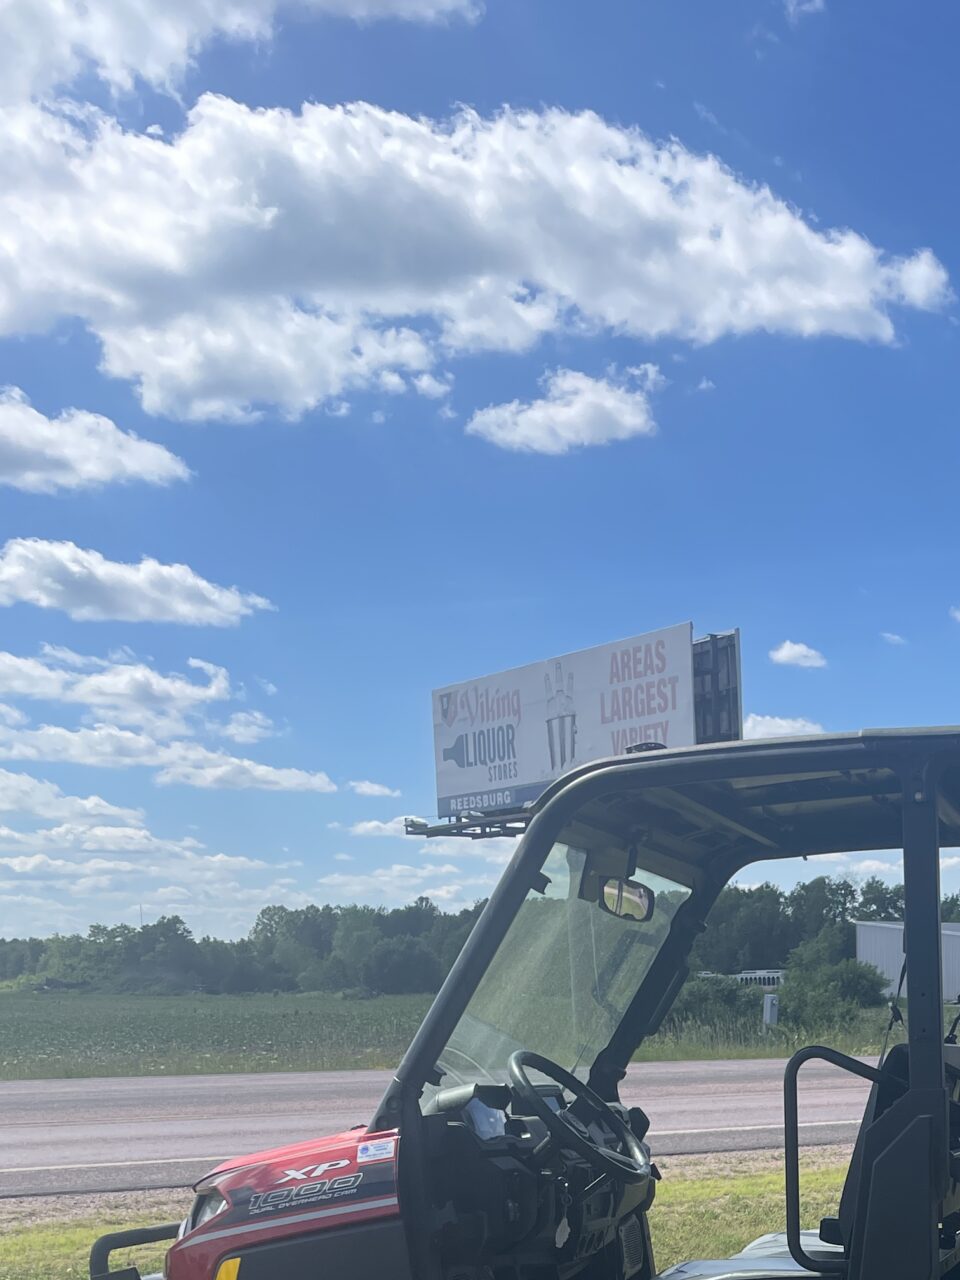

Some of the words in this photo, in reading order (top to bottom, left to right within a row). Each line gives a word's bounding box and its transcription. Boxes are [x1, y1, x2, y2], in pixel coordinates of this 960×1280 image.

[609, 639, 666, 685] AREAS
[459, 686, 522, 727] Viking
[600, 675, 679, 725] LARGEST
[465, 724, 516, 768] LIQUOR
[488, 761, 518, 782] STORES
[450, 790, 511, 813] REEDSBURG
[273, 1159, 351, 1184] XP
[248, 1205, 276, 1215] DUAL
[278, 1194, 333, 1209] OVERHEAD
[334, 1188, 358, 1198] CAM
[249, 1173, 363, 1209] 1000
